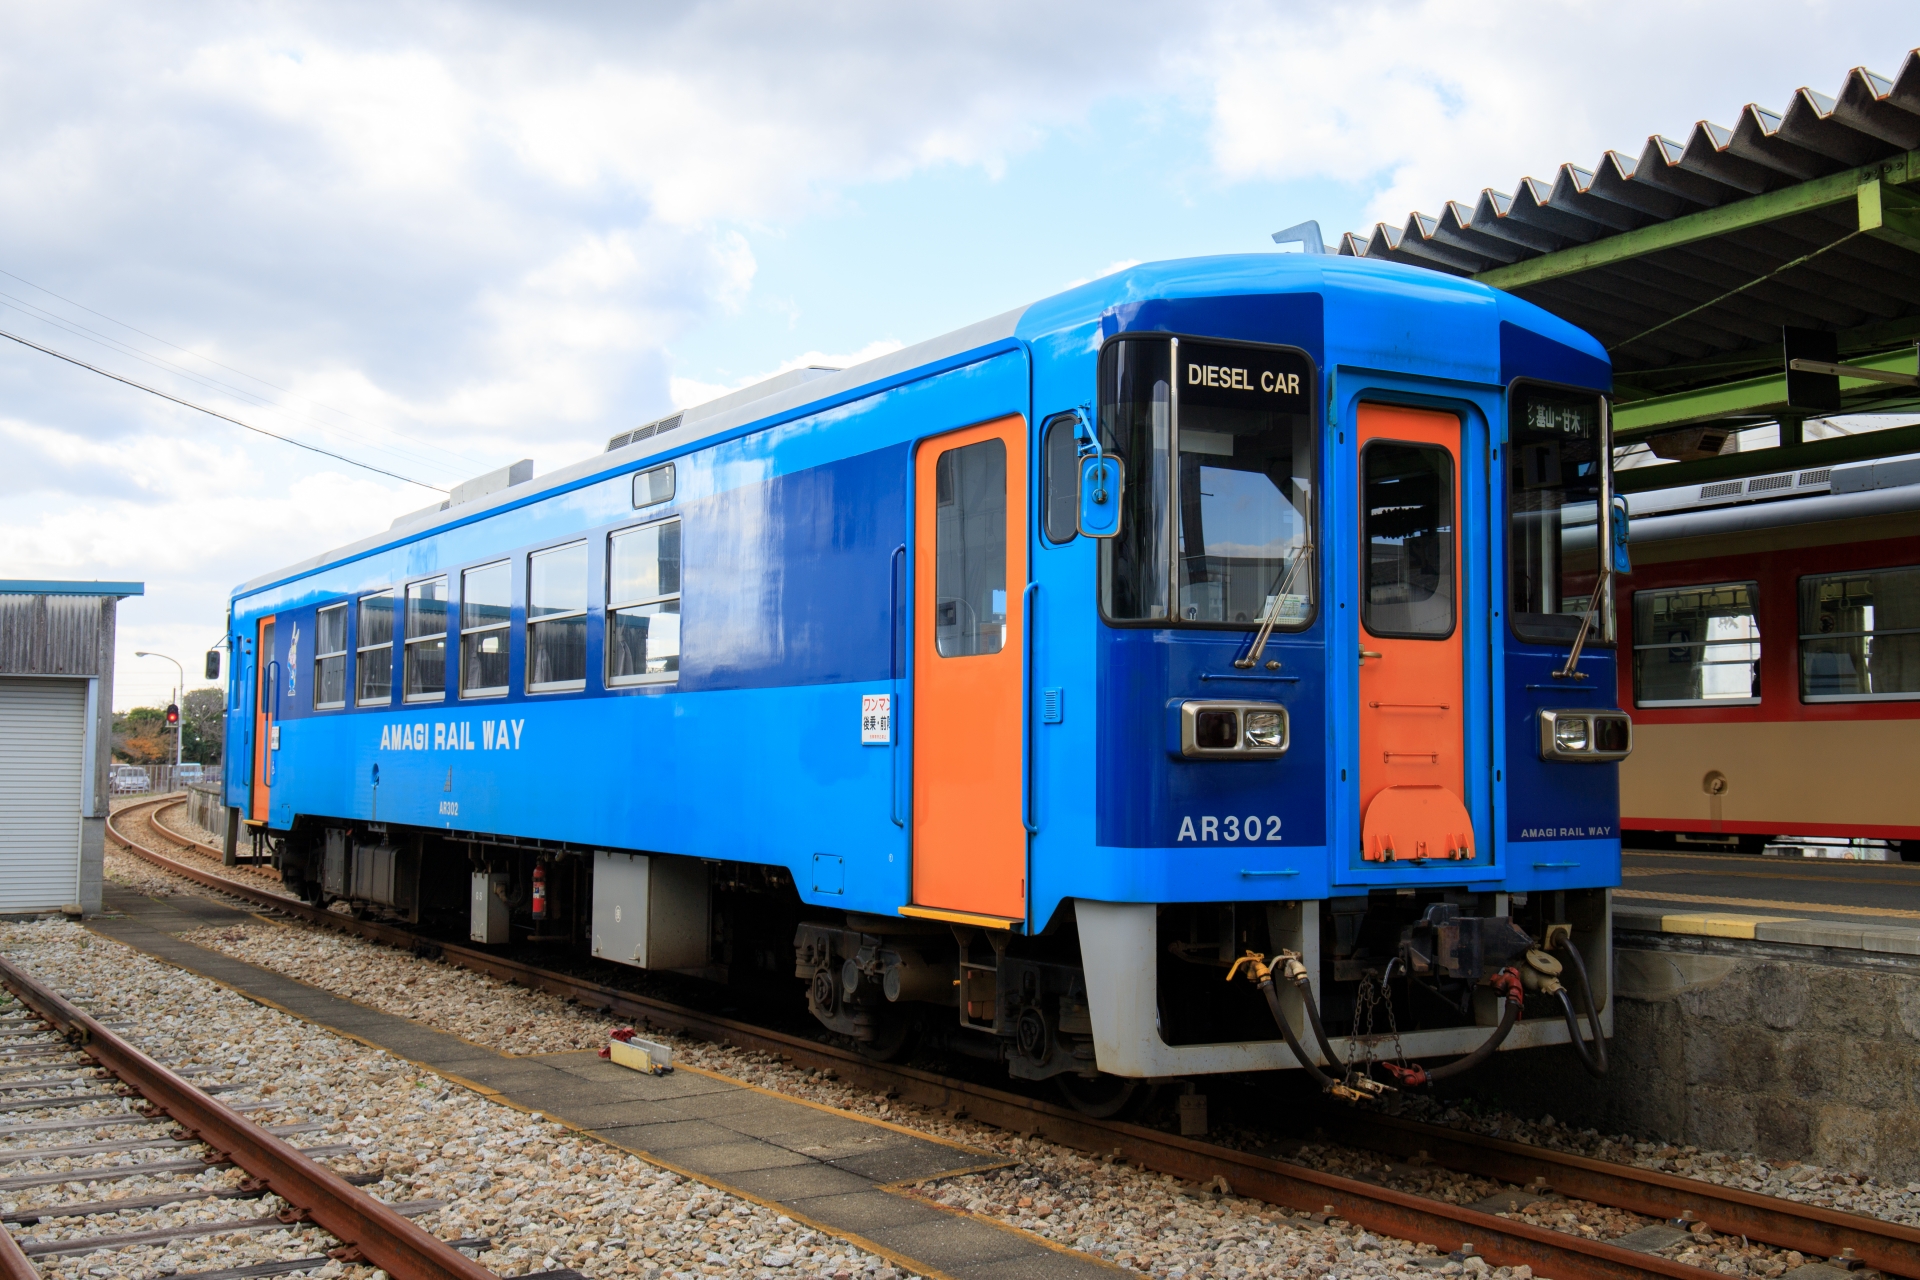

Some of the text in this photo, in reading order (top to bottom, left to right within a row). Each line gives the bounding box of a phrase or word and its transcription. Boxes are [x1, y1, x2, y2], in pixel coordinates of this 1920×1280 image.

[1188, 363, 1300, 395] DIESEL CAR
[380, 718, 526, 751] AMAGI RAIL WAY
[438, 801, 459, 816] AR302
[1177, 815, 1282, 842] AR302
[1521, 826, 1611, 838] AMAGI RAIL WAY
